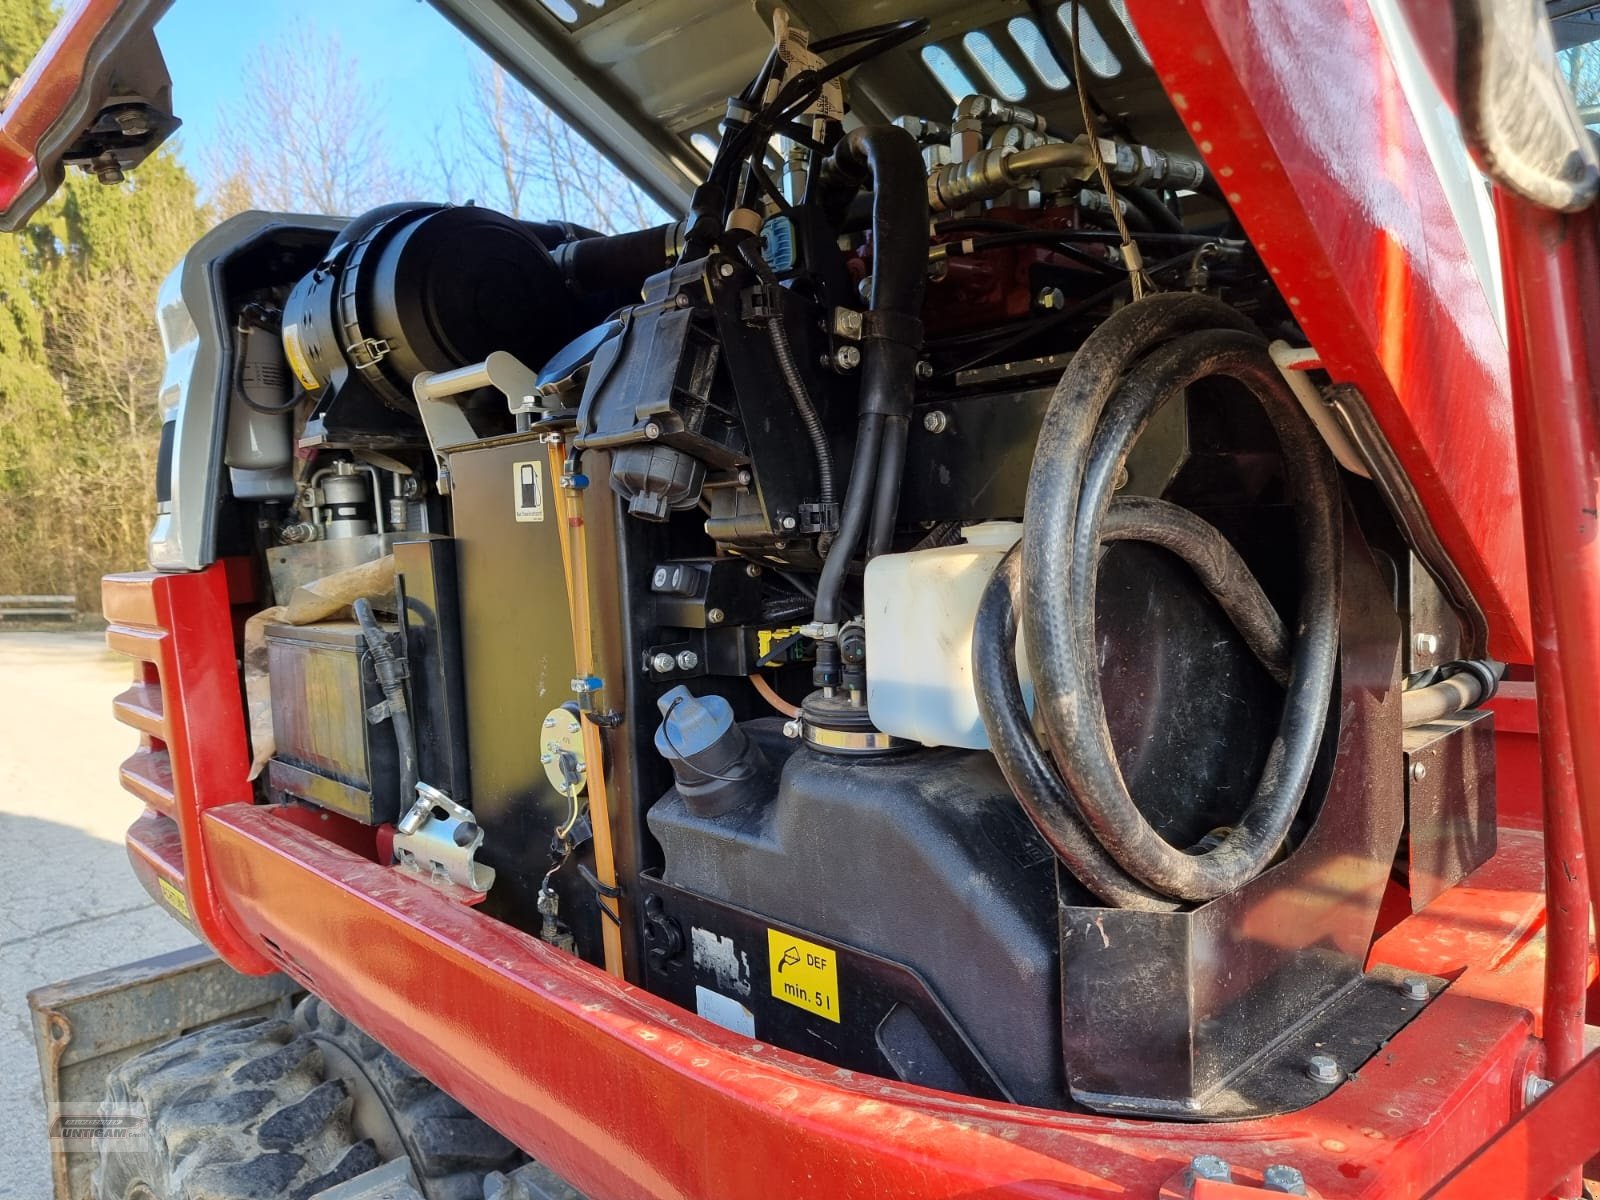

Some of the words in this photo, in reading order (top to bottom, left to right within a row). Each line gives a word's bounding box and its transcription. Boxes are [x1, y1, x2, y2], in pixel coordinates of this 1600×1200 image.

[806, 953, 828, 971] DEF
[784, 982, 812, 1003] min.
[815, 991, 823, 1007] 5
